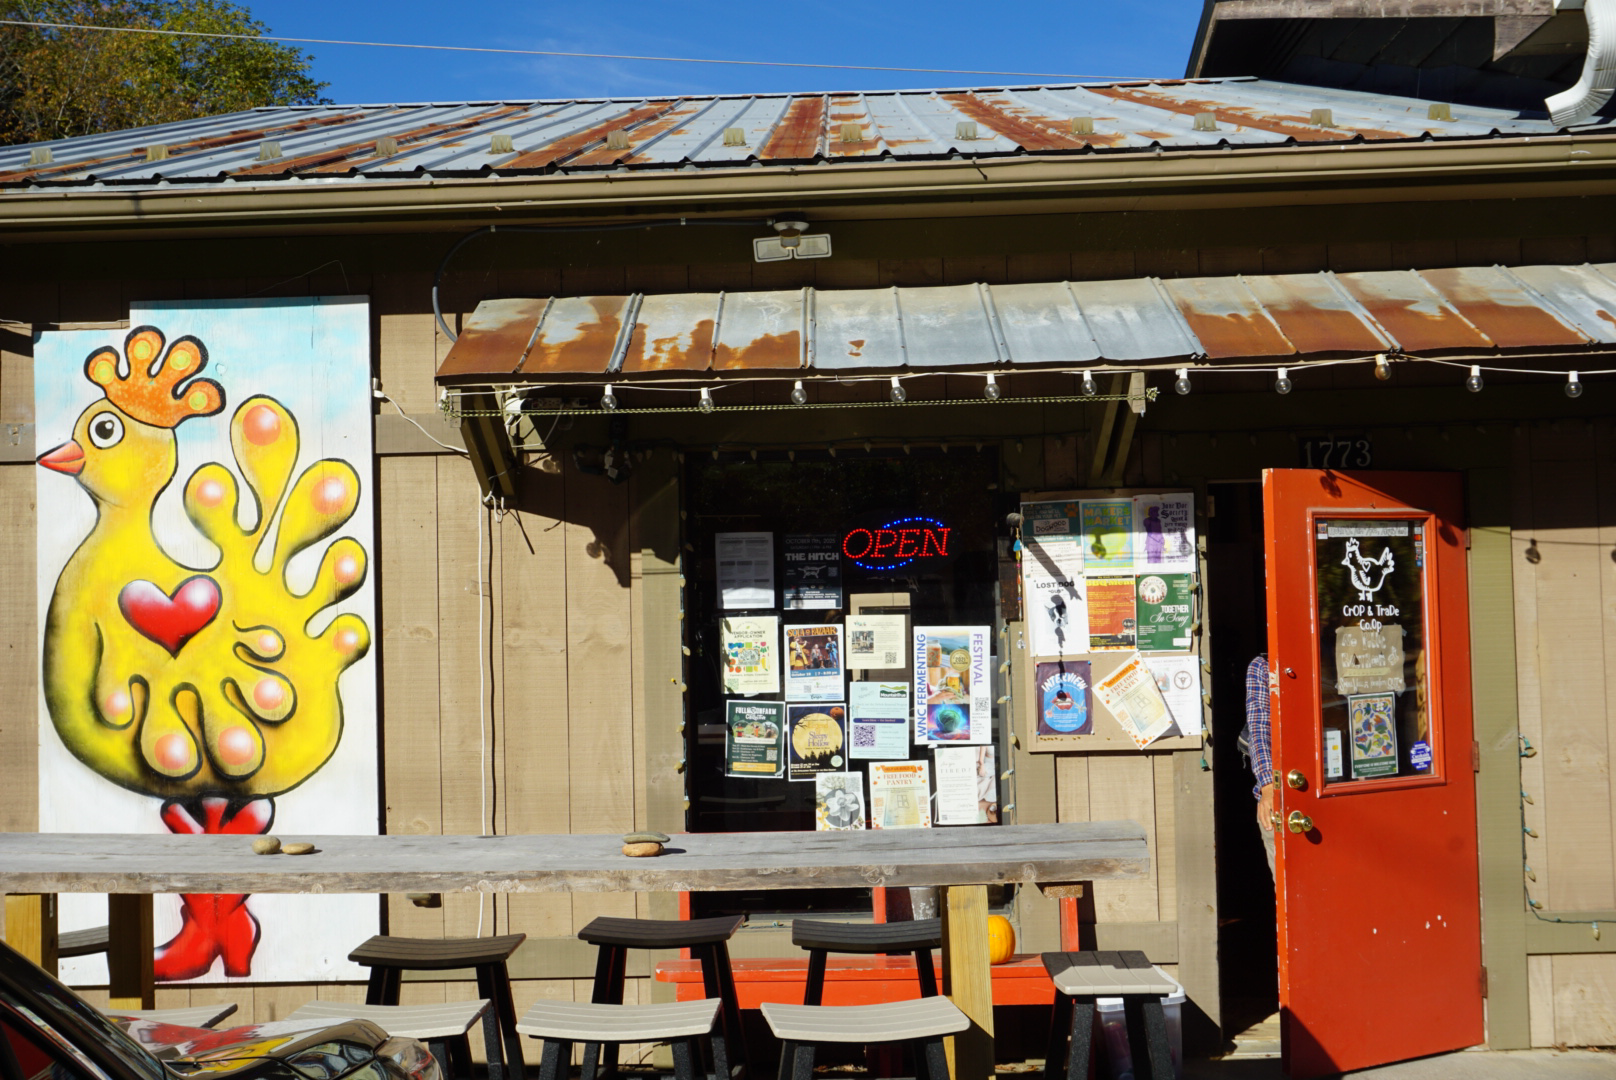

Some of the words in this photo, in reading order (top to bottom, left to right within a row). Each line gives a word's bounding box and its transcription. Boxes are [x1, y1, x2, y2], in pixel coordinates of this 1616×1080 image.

[1303, 440, 1371, 468] 1773
[1084, 506, 1131, 517] MAKERS
[1084, 516, 1131, 526] MARKET
[843, 528, 951, 558] OPEN
[785, 552, 806, 561] THE
[808, 552, 839, 560] HITCH
[1160, 604, 1189, 614] TOGETHER
[1367, 605, 1374, 616] &
[973, 633, 983, 686] FESTIVAL
[917, 633, 927, 705] FERMENTING
[1041, 672, 1089, 693] INTERVIEW
[917, 708, 927, 738] WNC
[808, 731, 829, 741] Sleepy
[808, 738, 829, 748] Hollow
